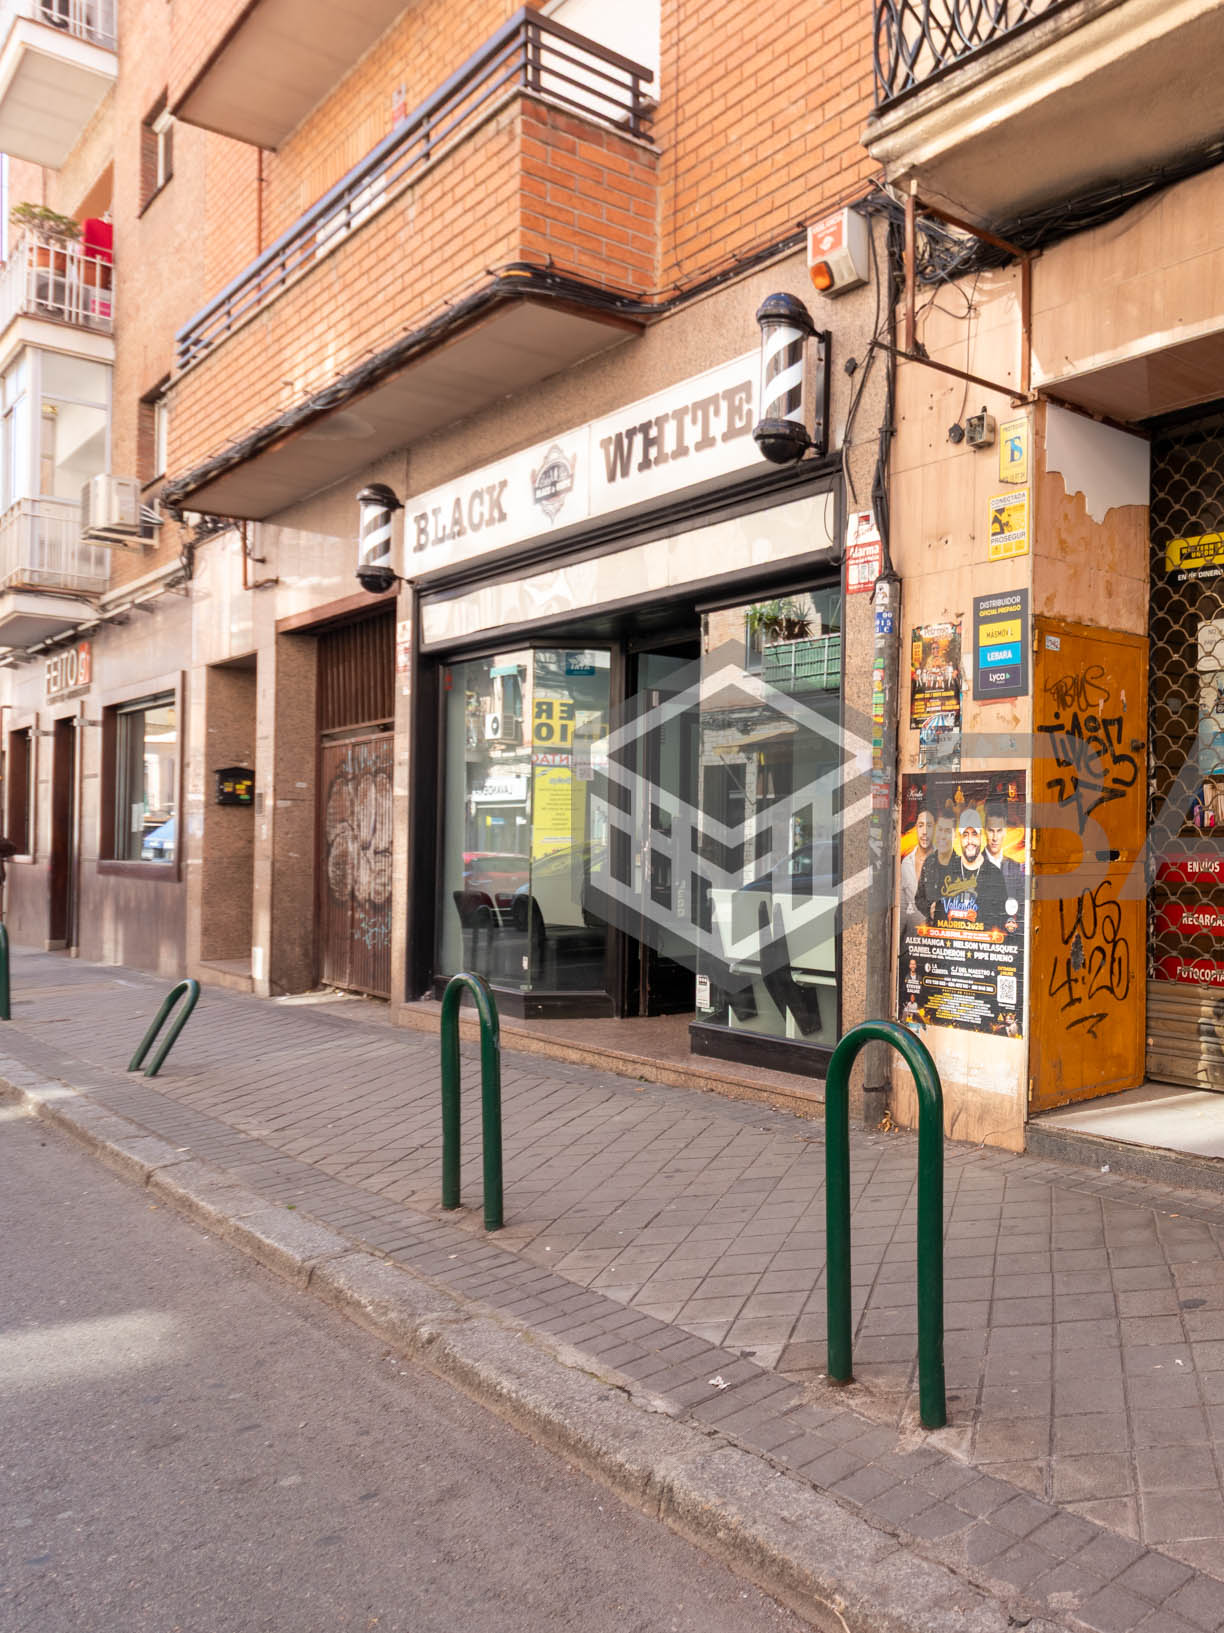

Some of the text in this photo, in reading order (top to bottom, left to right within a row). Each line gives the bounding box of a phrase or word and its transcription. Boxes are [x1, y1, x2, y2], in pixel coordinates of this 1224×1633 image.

[600, 380, 754, 484] WHITE
[412, 479, 508, 553] BLACK
[990, 531, 1026, 545] PROSEGUR
[979, 595, 1021, 609] DISTRIBUIDOR
[987, 649, 1012, 662] LEBARA
[1187, 860, 1221, 874] ENVÍOS
[979, 943, 1018, 953] VELASQUEZ
